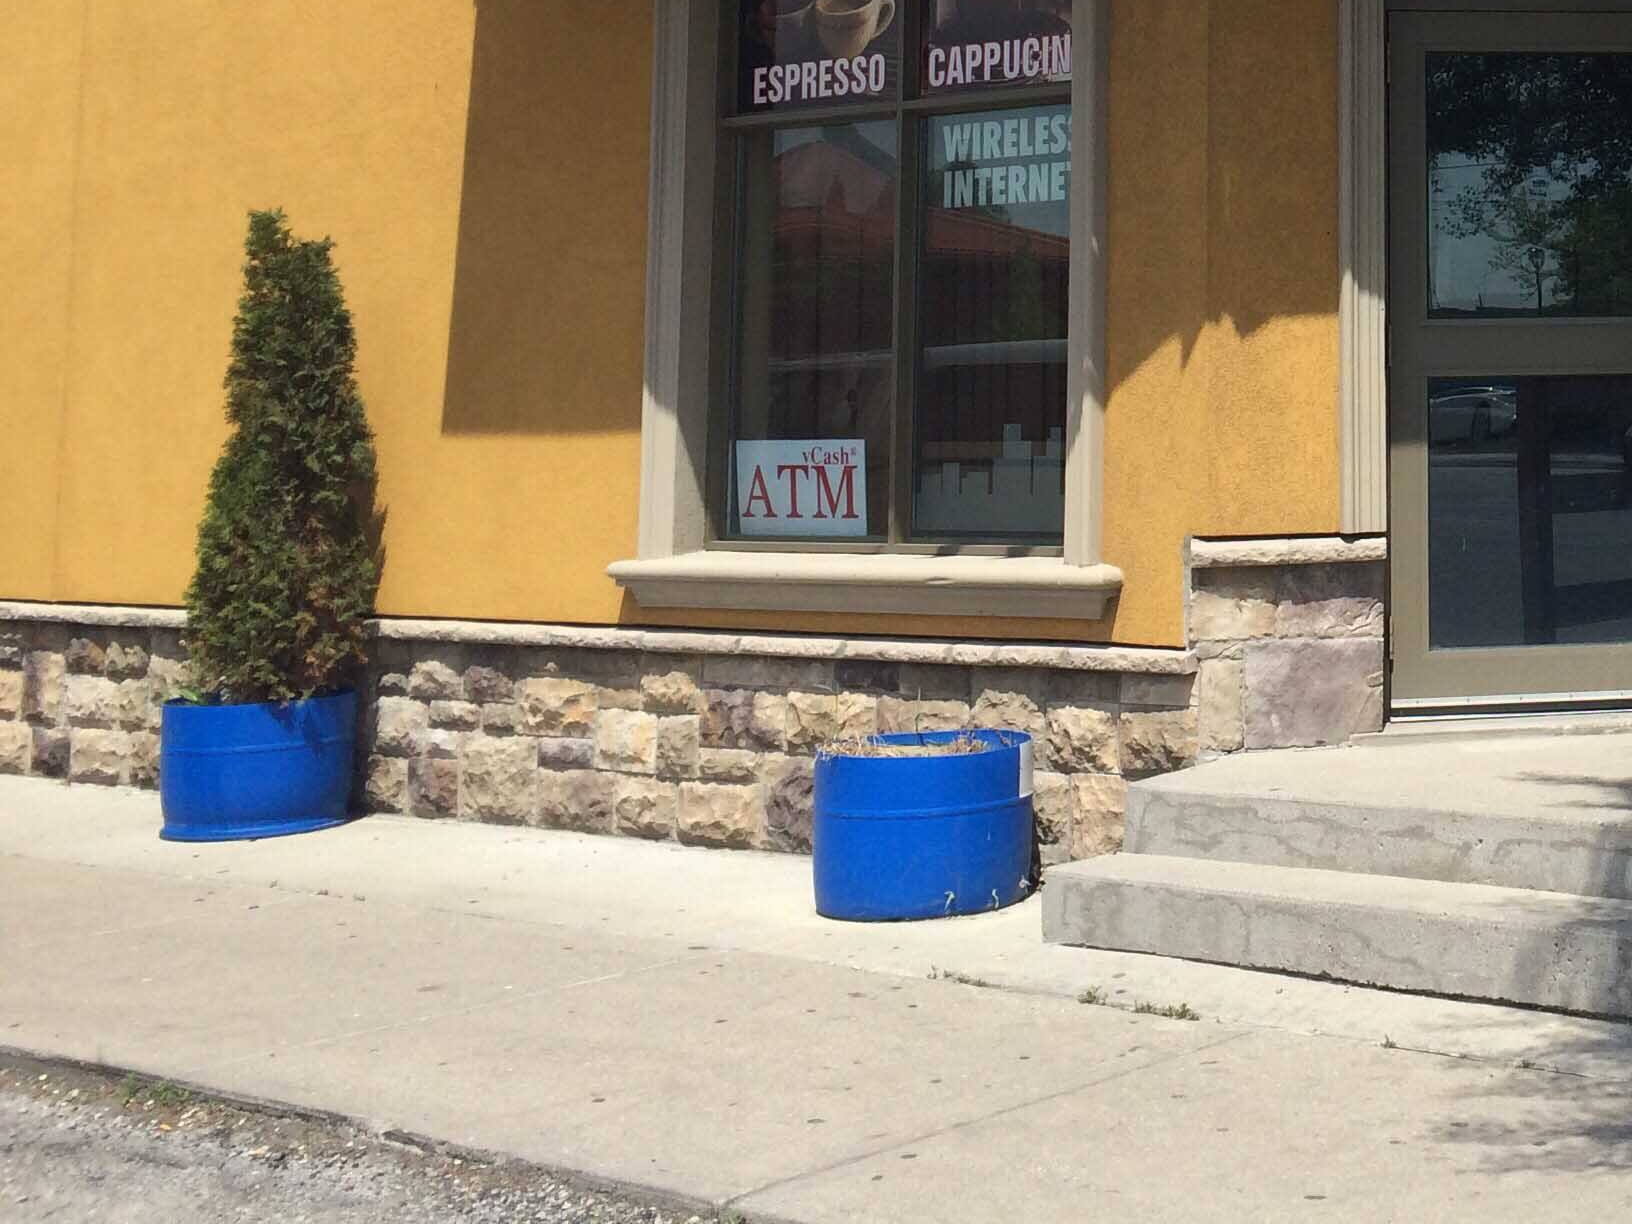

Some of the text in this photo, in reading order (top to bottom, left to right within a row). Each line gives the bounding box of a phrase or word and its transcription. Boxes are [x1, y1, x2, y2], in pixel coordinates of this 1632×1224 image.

[754, 54, 886, 104] ESPRESSO
[943, 162, 1071, 208] INTERNE
[742, 465, 859, 519] ATM
